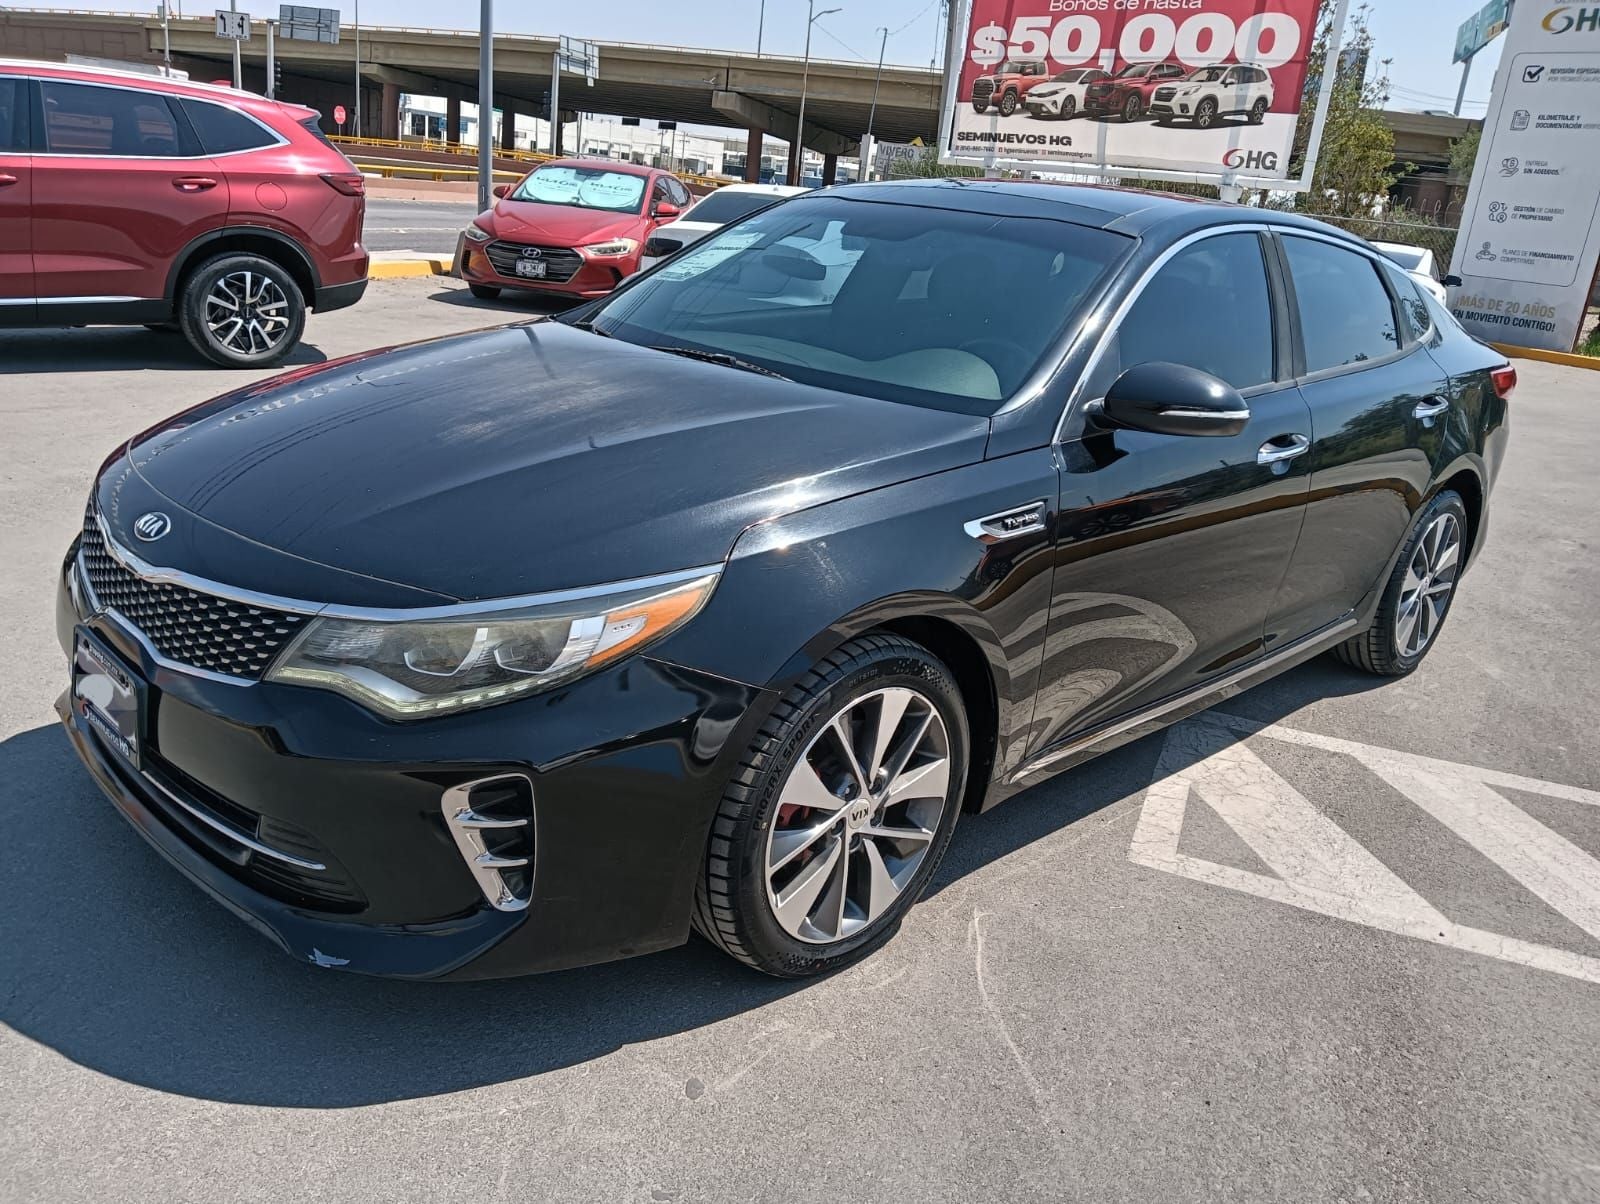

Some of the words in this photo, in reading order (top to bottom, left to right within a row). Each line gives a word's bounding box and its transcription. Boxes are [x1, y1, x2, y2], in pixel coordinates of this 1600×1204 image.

[1049, 0, 1109, 12] Bonos
[1113, 0, 1139, 10] de
[1575, 7, 1600, 32] H
[970, 12, 1301, 74] $50,000
[957, 131, 1047, 145] SEMINUEVOS
[1049, 135, 1072, 146] HG
[1245, 149, 1278, 170] HG
[1529, 251, 1575, 261] FINANCIAMIENTO
[1487, 298, 1504, 311] DE
[1505, 301, 1520, 314] 20
[1521, 300, 1556, 318] AÑOS
[1465, 312, 1511, 325] MOVIENTO
[1512, 317, 1556, 332] CONTIGO!
